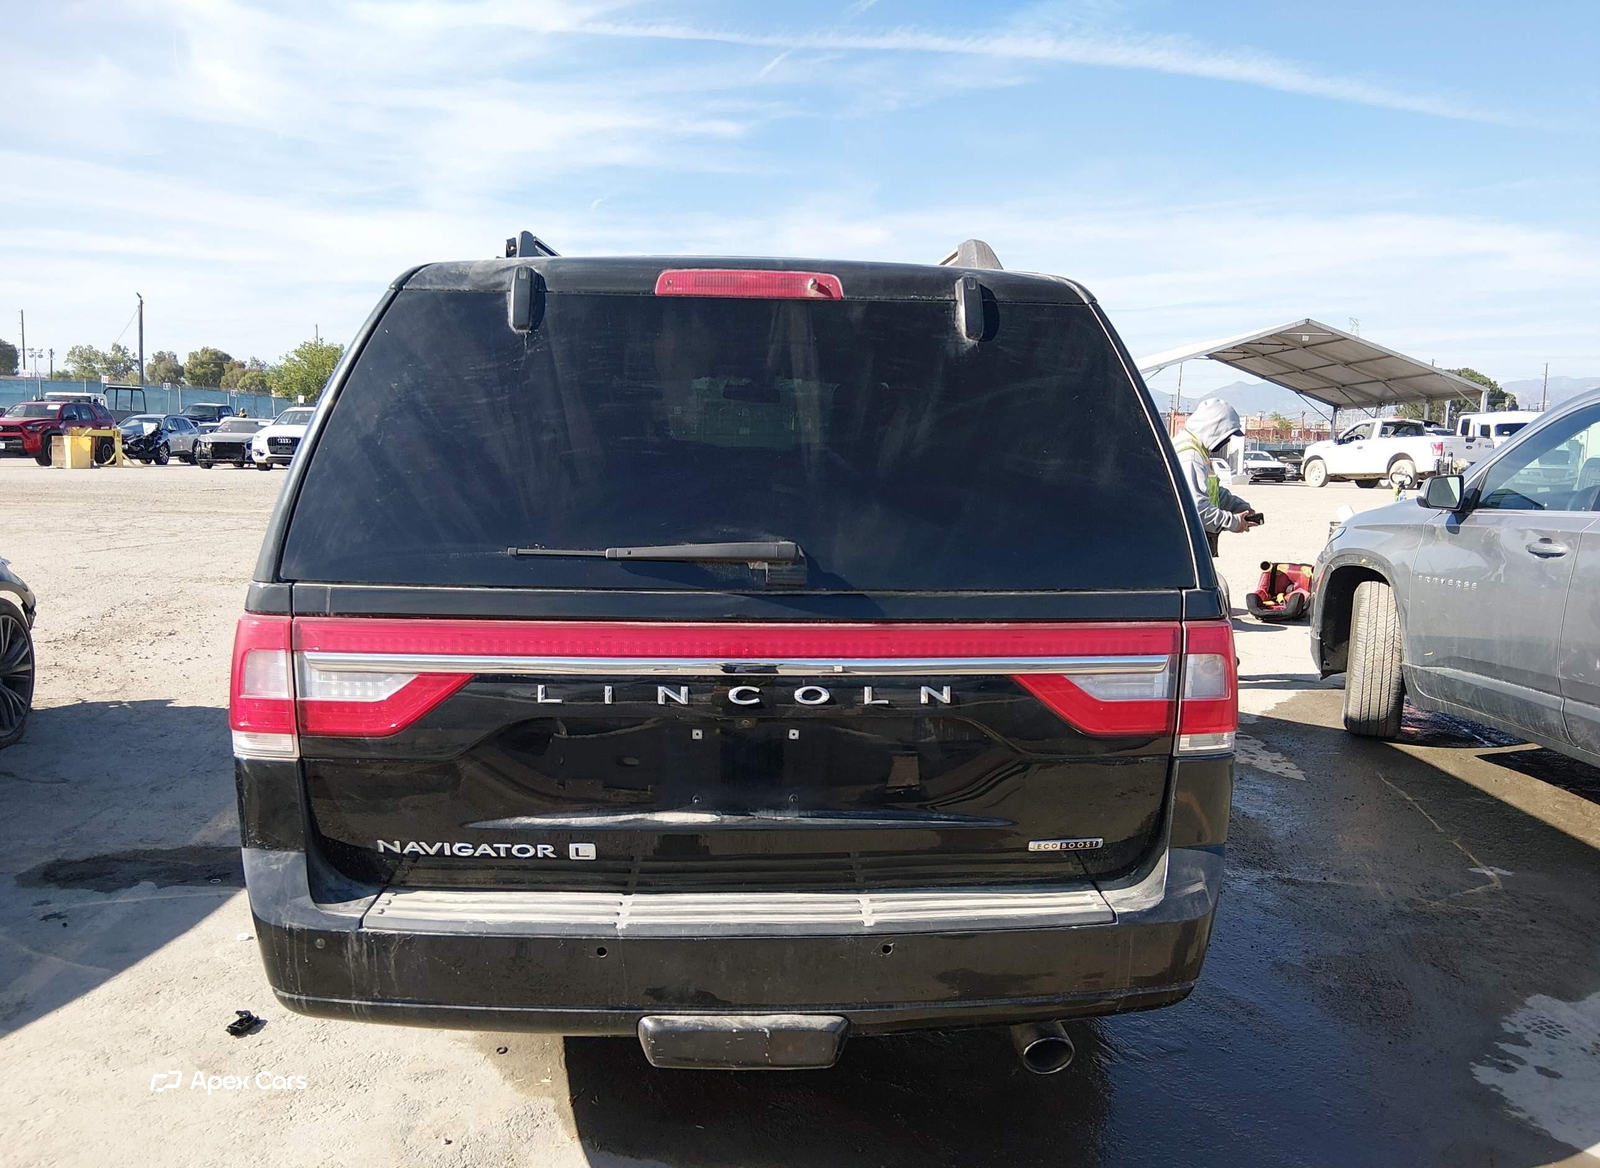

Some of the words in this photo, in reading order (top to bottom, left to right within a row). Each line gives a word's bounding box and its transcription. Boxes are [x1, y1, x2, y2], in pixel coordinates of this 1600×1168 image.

[536, 685, 951, 705] LINCOLN
[376, 839, 558, 858] NAVIGATOR
[1036, 840, 1099, 851] ECOBOOST
